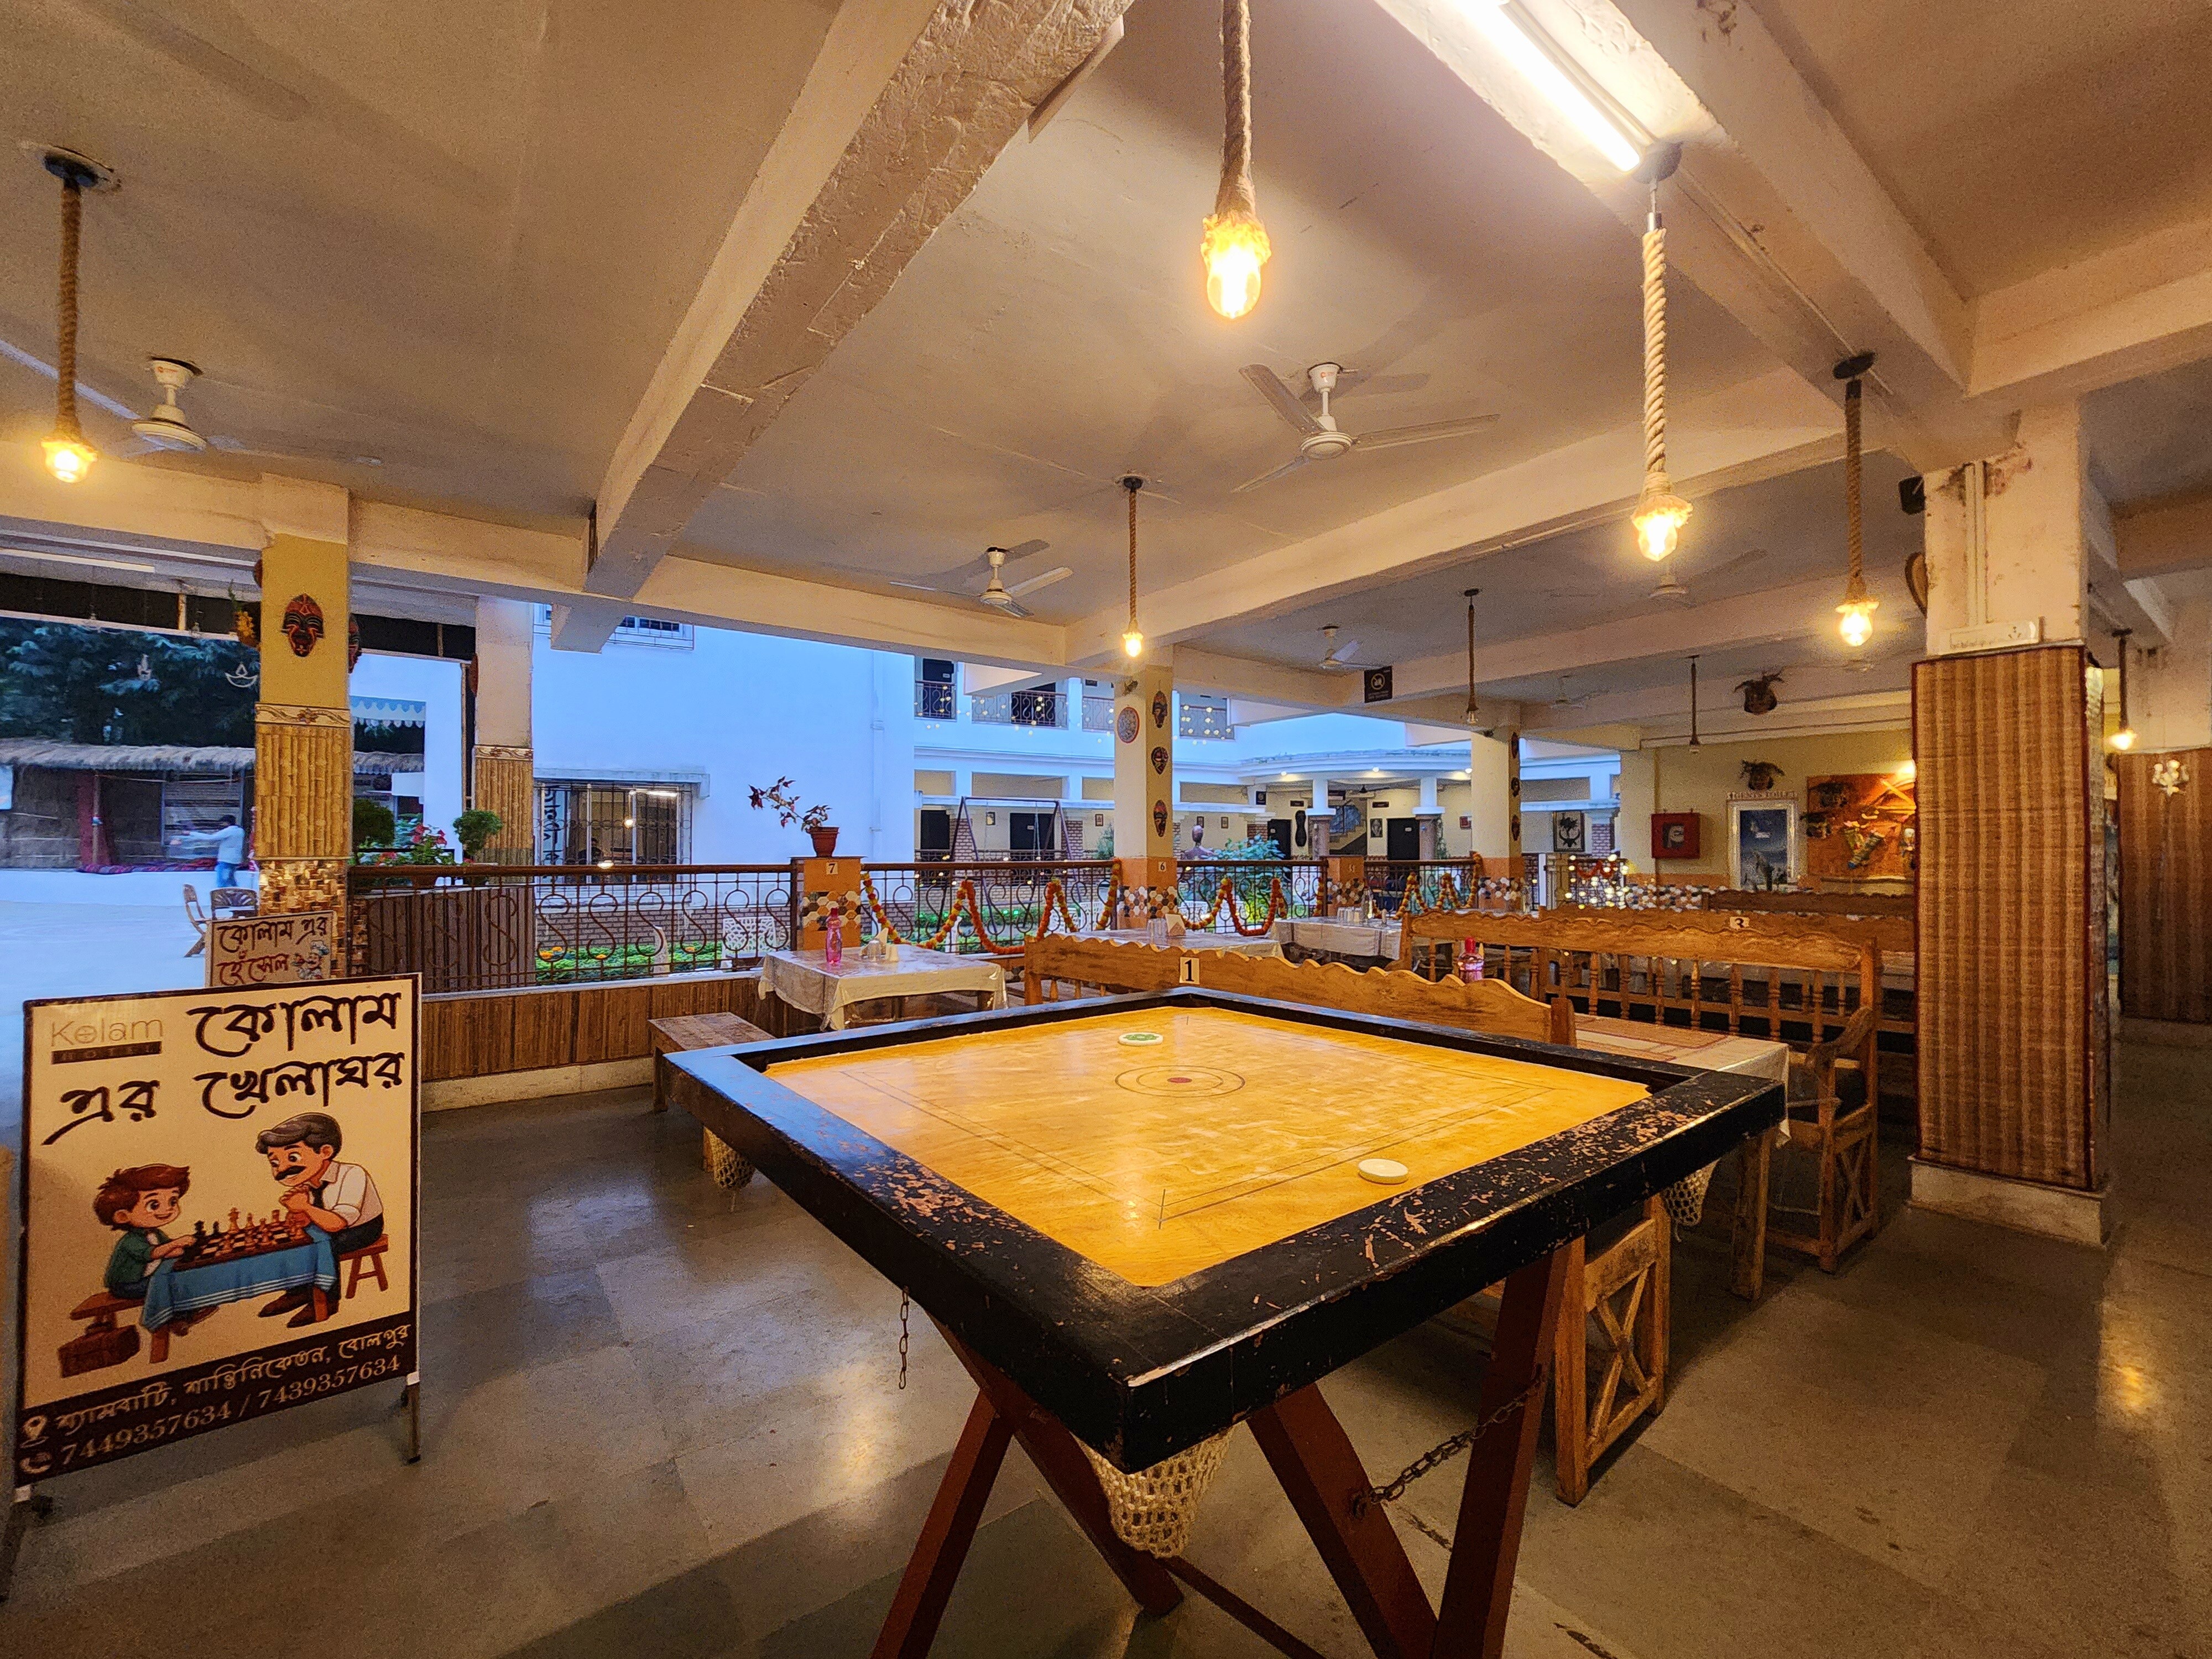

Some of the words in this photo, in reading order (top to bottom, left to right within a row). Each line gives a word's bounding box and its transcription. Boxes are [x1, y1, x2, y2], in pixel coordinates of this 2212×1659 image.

[828, 863, 836, 874] 7
[1160, 862, 1165, 871] 6
[217, 921, 294, 953] কোলাম
[296, 916, 328, 945] এর
[1184, 959, 1194, 982] 1
[186, 992, 401, 1057] কোলাম
[40, 1079, 160, 1145] এর
[193, 1051, 405, 1119] খেলাঘর
[338, 1324, 411, 1359] বোলপুর
[60, 1399, 232, 1465] 7449357634
[259, 1354, 401, 1409] 7439357634
